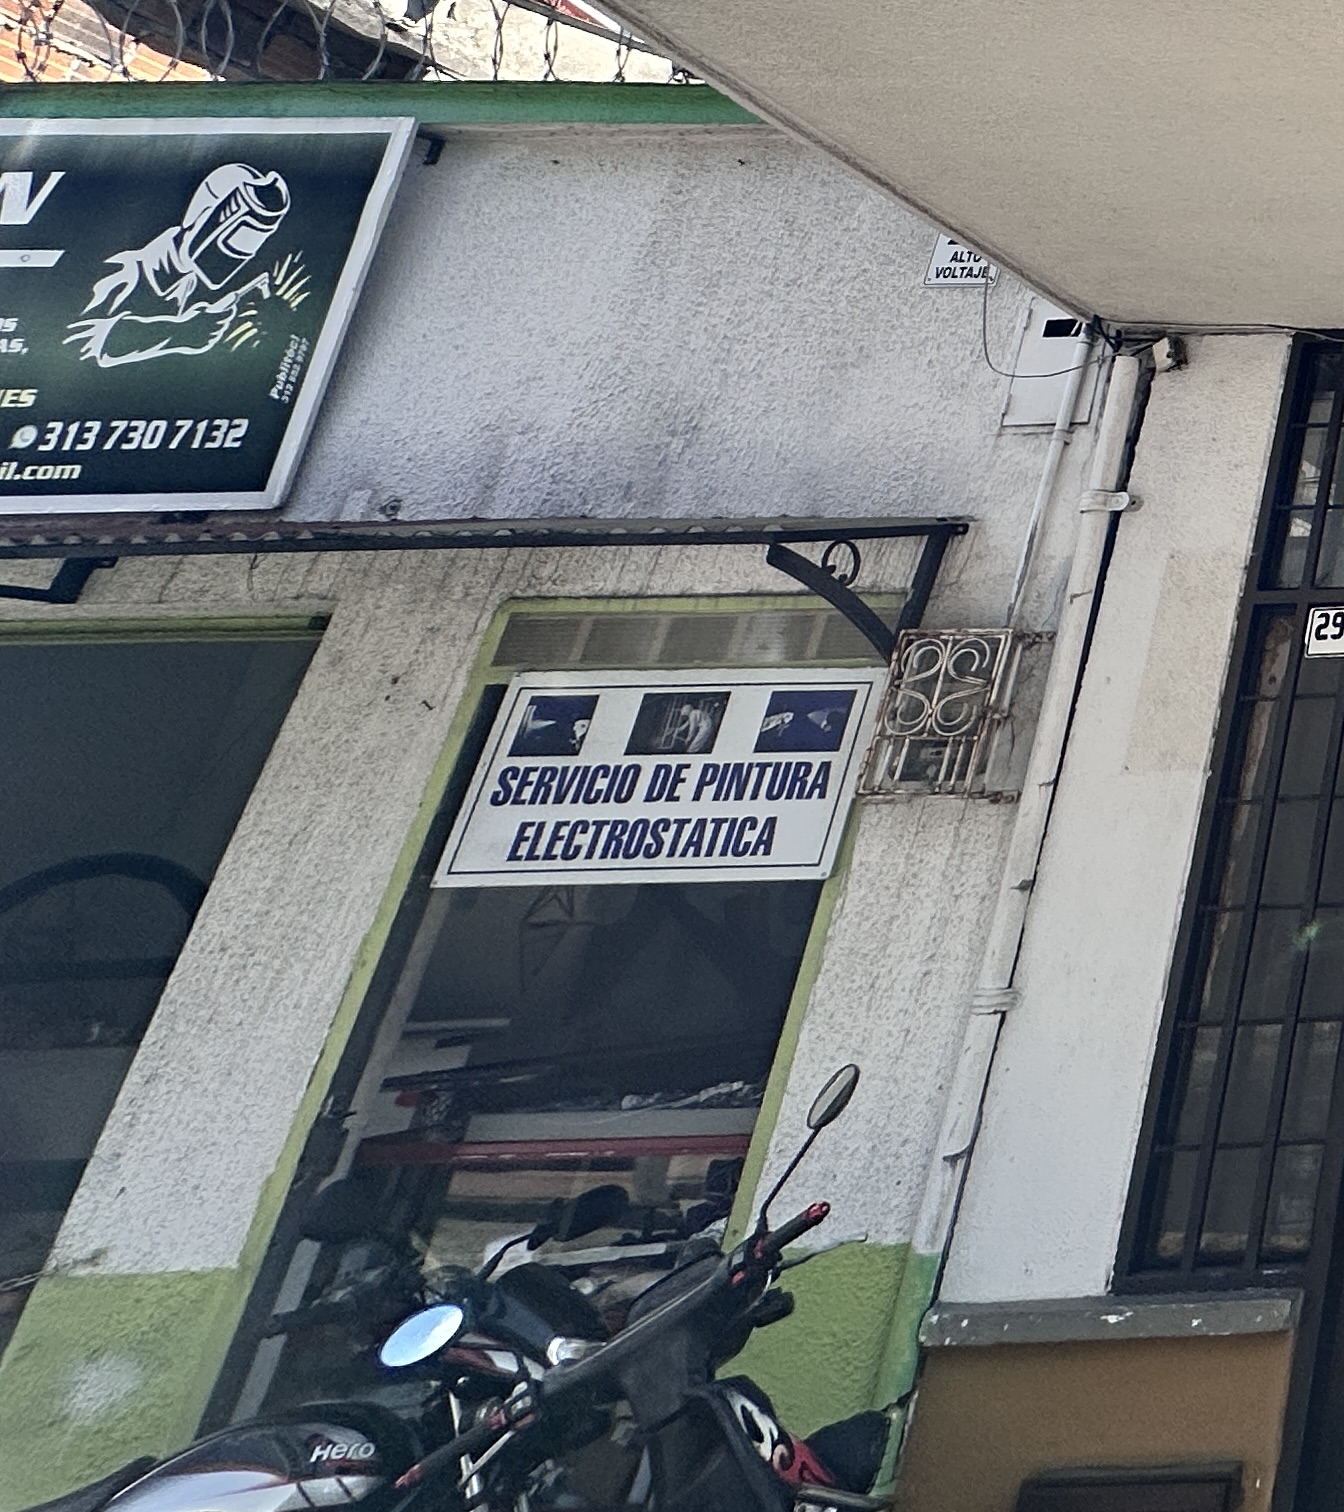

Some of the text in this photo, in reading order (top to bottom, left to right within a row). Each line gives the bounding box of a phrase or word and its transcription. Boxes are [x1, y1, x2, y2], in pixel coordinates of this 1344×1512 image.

[936, 266, 989, 279] VOLTAJE
[37, 418, 249, 451] 313 730 7132
[490, 761, 832, 806] SERVICIO DE PINTURA
[506, 816, 778, 862] ELECTROSTATICA
